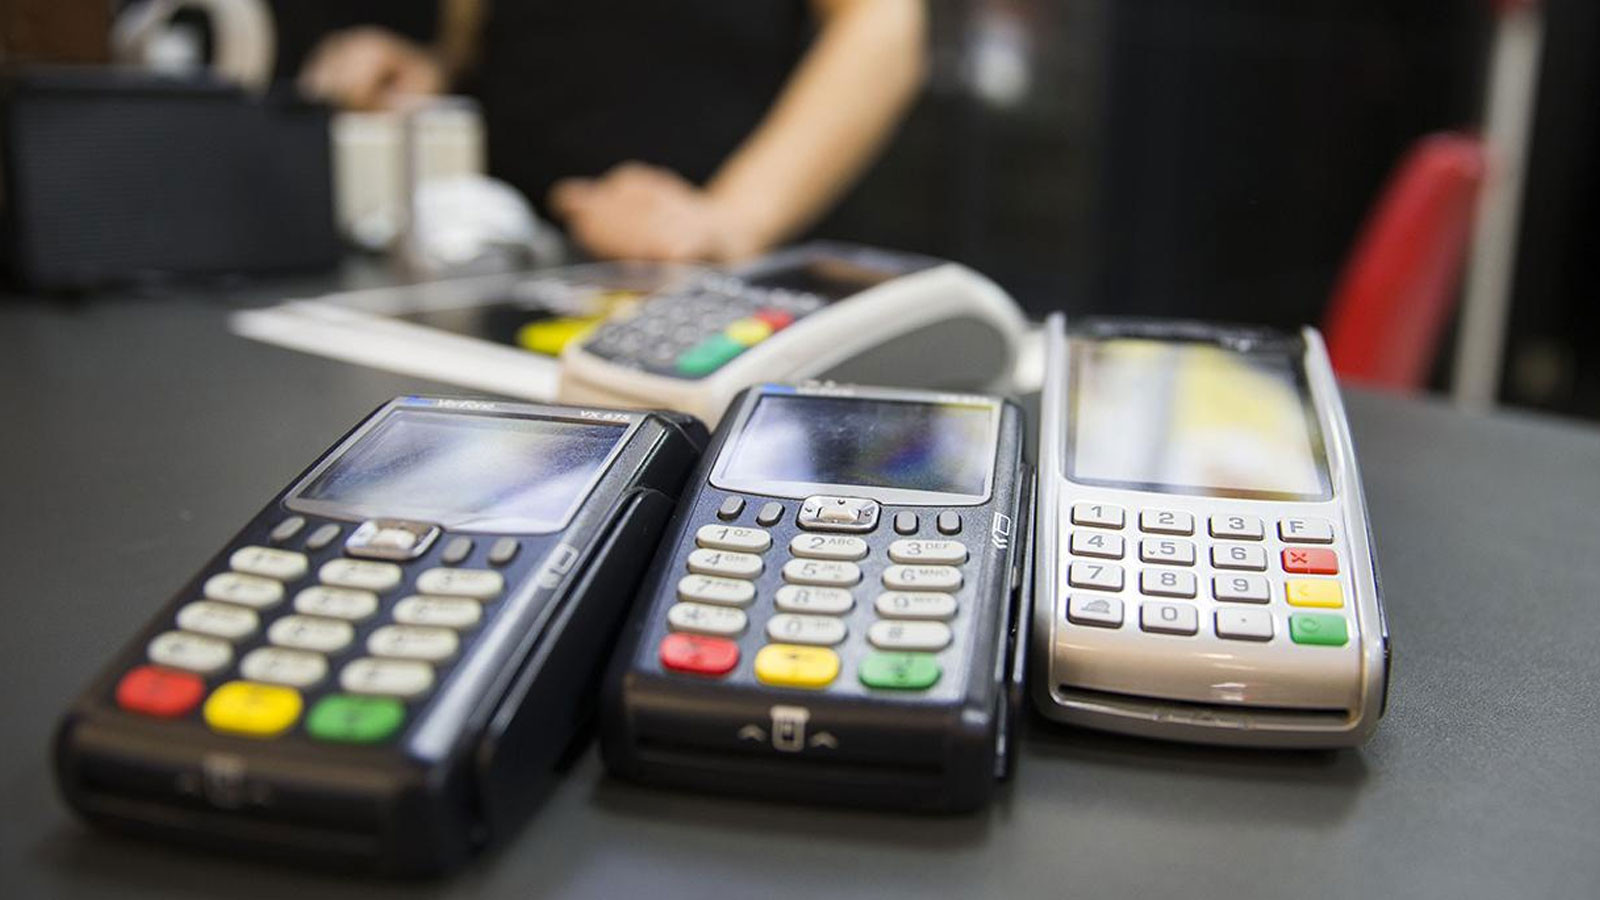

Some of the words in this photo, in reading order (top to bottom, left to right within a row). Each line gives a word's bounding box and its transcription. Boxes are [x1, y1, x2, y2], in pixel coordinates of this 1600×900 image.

[1090, 505, 1102, 518] 1
[1159, 512, 1175, 525] 2
[1229, 517, 1245, 530] 3
[1290, 521, 1304, 534] F
[809, 537, 826, 549] 2
[1087, 535, 1104, 548] 4
[906, 542, 922, 555] 3
[1160, 542, 1175, 555] 5
[1230, 547, 1246, 560] 6
[1088, 565, 1103, 579] 7
[1161, 572, 1176, 586] 8
[1233, 579, 1249, 592] 9
[1161, 607, 1177, 621] 0
